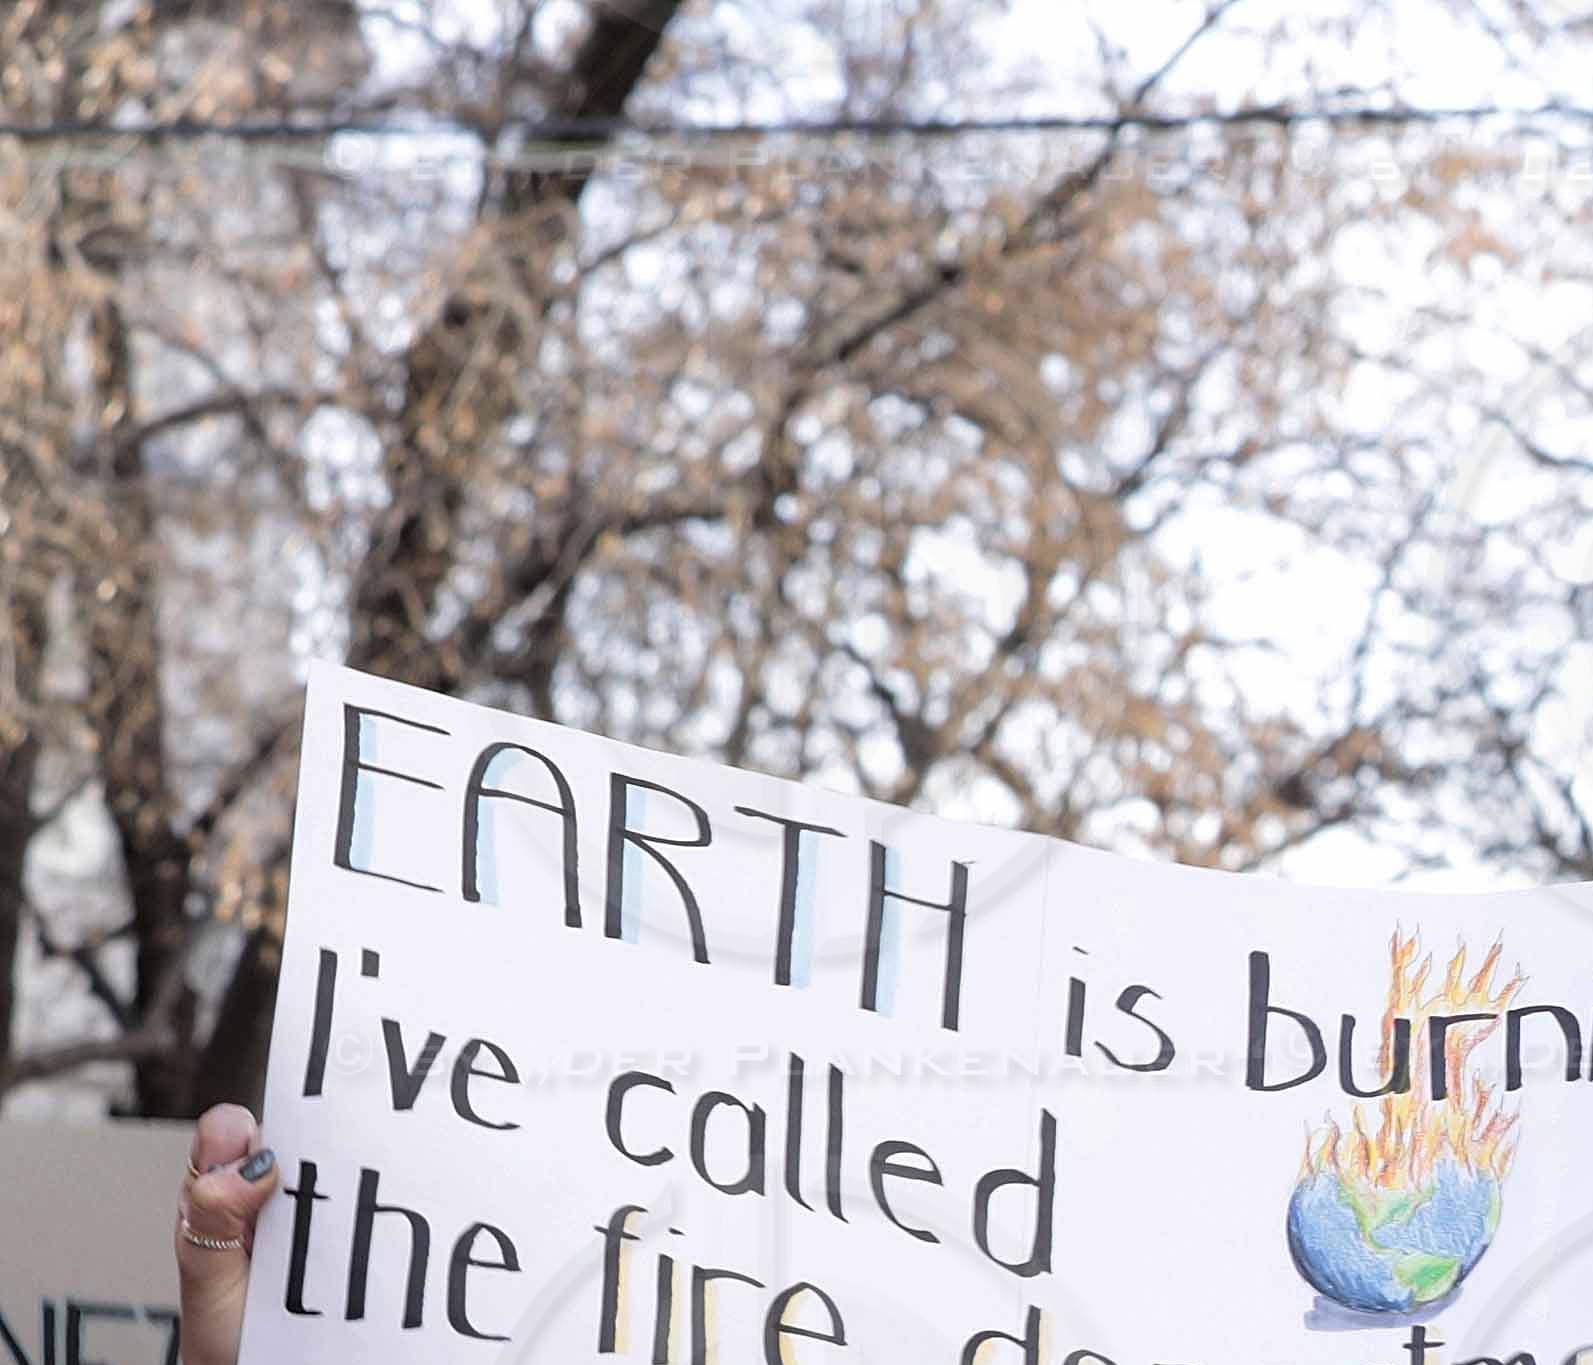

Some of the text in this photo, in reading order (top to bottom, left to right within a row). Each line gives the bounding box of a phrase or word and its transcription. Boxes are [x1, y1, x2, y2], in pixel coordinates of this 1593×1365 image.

[333, 703, 977, 1032] EARTH
[1065, 945, 1177, 1072] is
[284, 1158, 523, 1342] the
[302, 948, 1059, 1278] I've called
